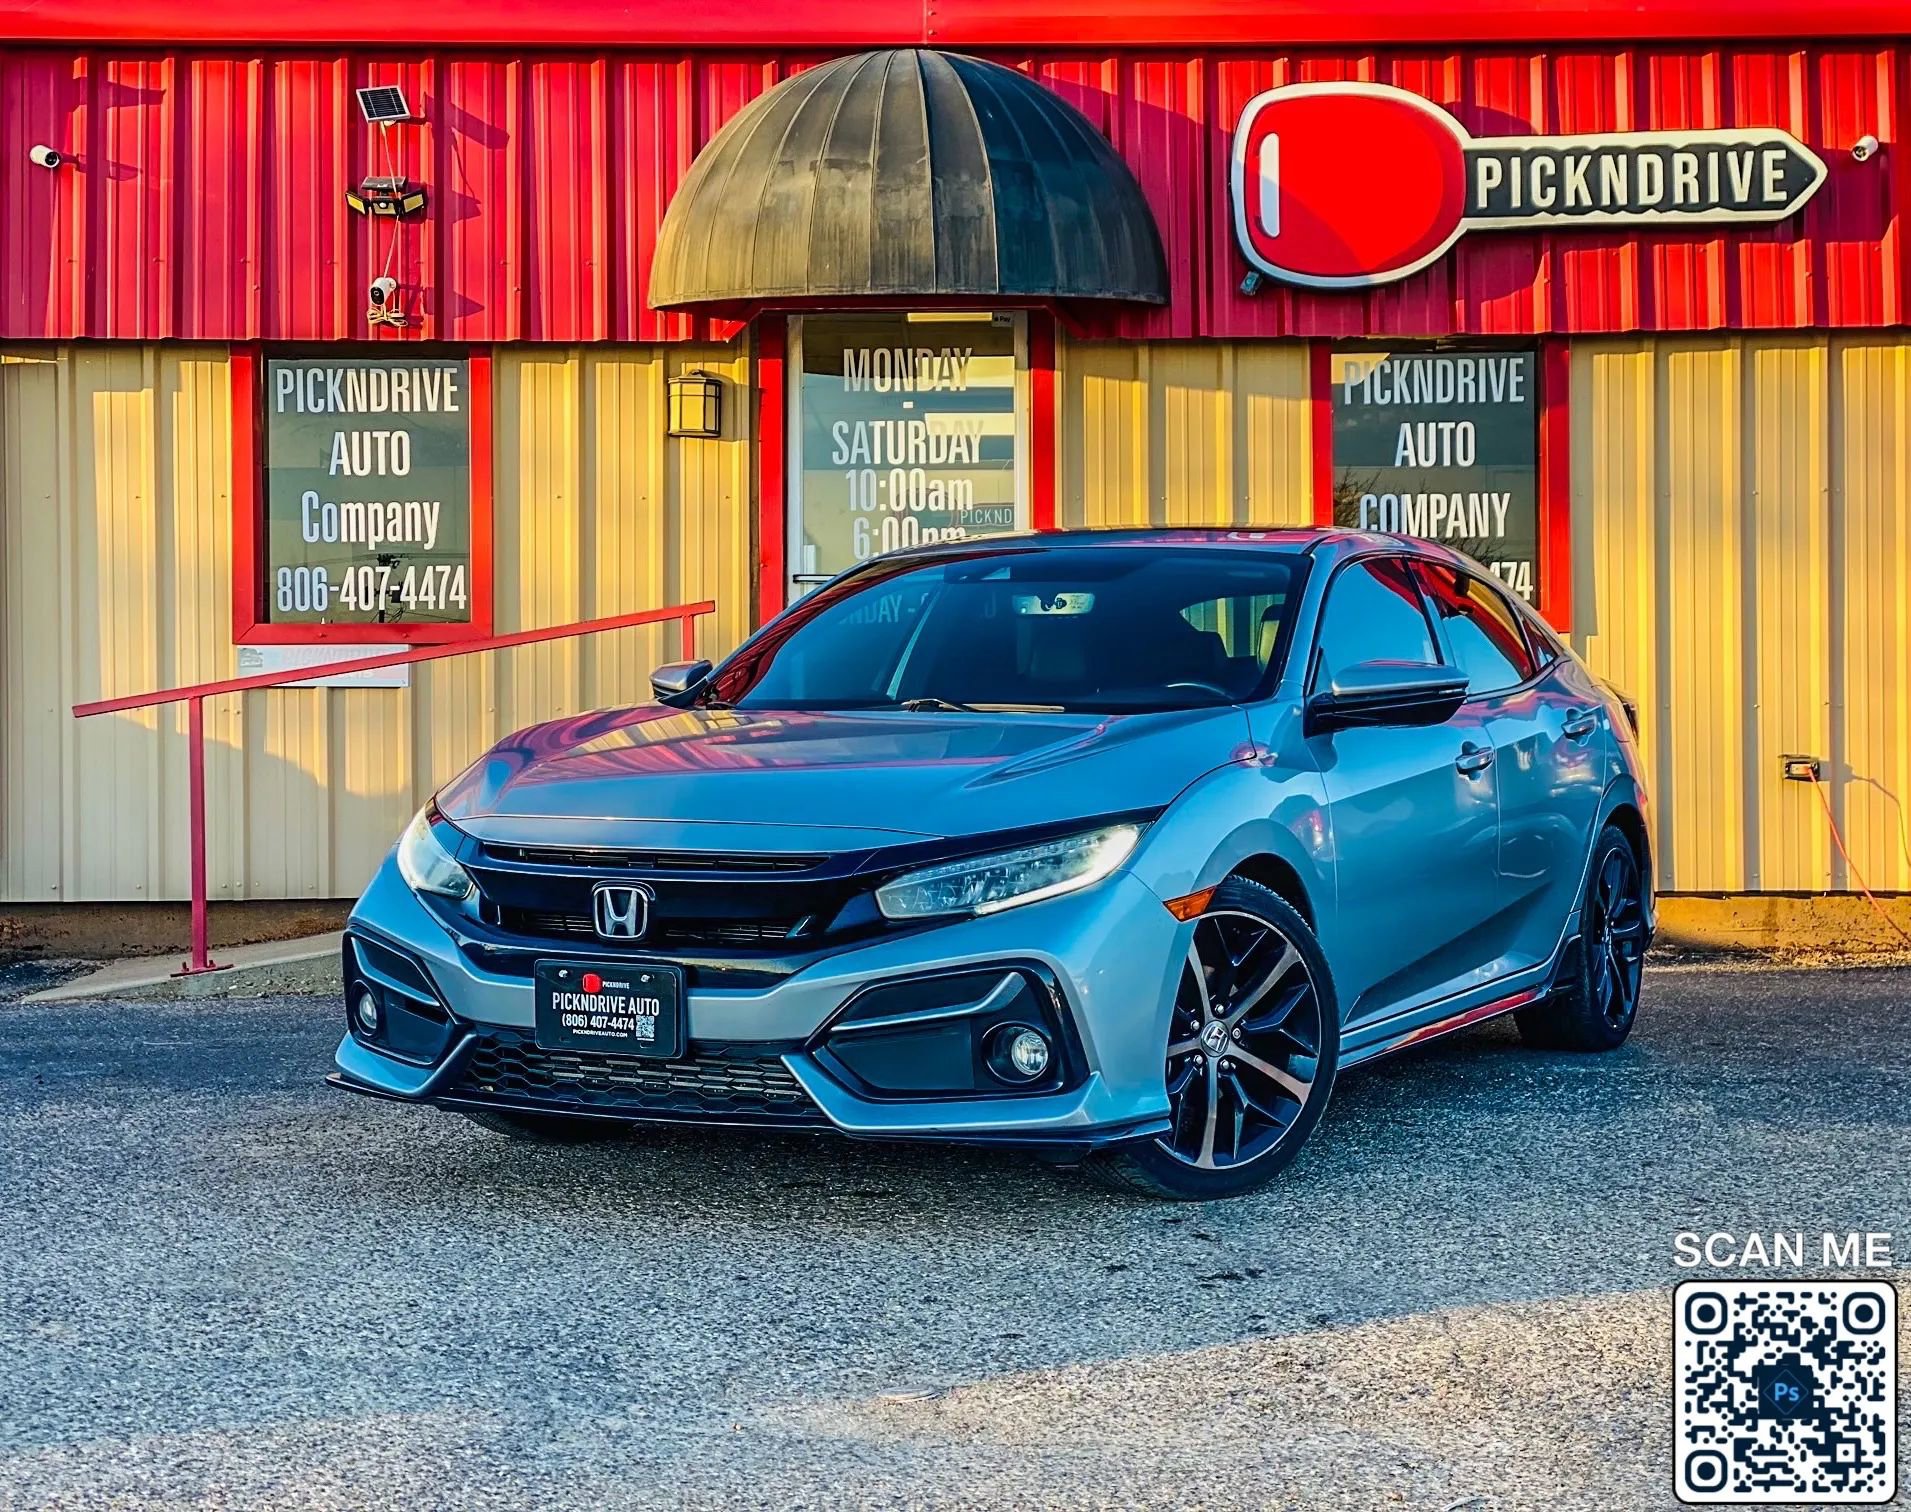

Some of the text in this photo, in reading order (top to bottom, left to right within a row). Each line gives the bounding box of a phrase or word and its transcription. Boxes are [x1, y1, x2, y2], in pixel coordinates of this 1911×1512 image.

[1477, 150, 1788, 209] PICKNDRIVE
[276, 367, 459, 413] PICKNDRIVE
[843, 348, 973, 392] MONDAY
[1344, 357, 1525, 405] PICKNDRIVE
[329, 431, 411, 476] AUTO
[832, 420, 985, 465] SATURDAY
[1394, 421, 1476, 468] AUTO
[845, 468, 973, 512] 10:00am
[301, 491, 440, 550] Company
[1359, 492, 1511, 538] COMPANY
[277, 565, 466, 611] 806-407-4474
[552, 992, 660, 1016] PICKNDRIVE AUTO
[602, 981, 630, 989] PICKNDRIVE
[562, 1013, 634, 1031] (806) 407-4474
[572, 1028, 628, 1038] PICKNDRIVEAUTO.COM
